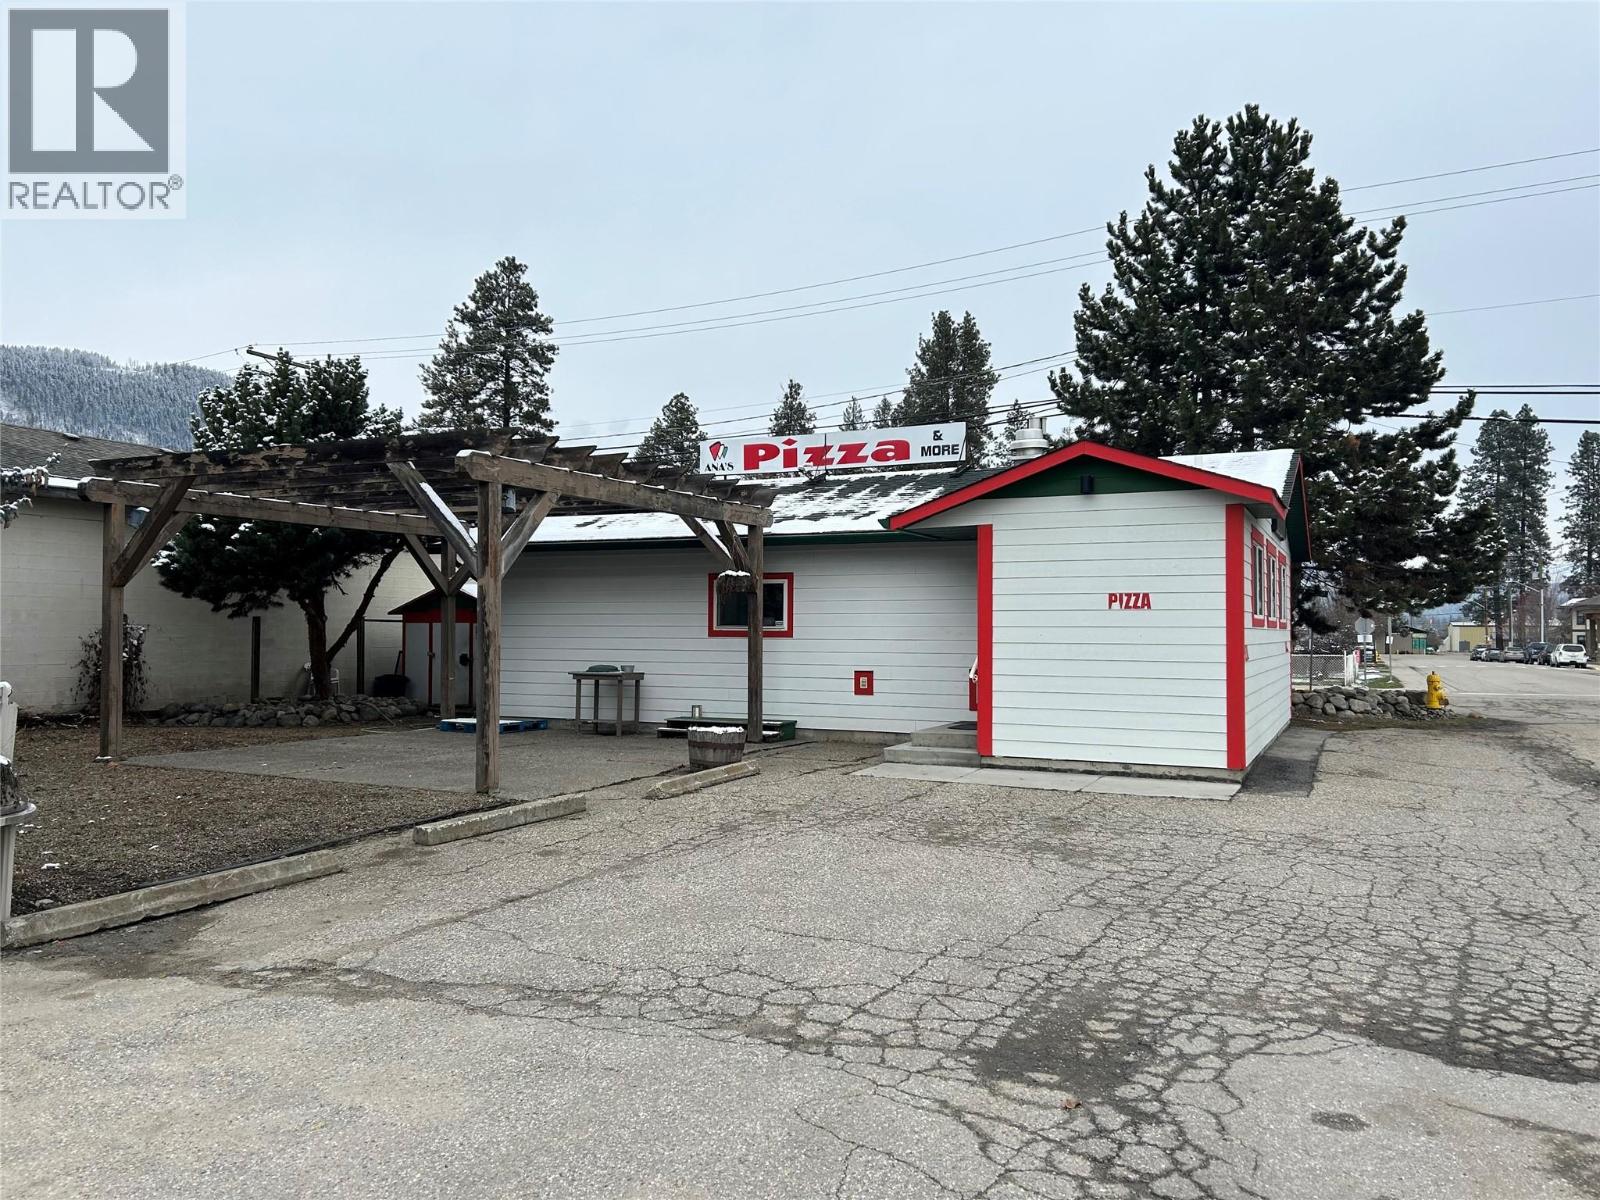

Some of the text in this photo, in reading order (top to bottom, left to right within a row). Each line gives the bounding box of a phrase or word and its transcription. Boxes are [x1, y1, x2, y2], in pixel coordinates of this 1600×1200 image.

[932, 430, 943, 441] &
[743, 437, 911, 471] Pizza
[920, 443, 960, 457] MORE
[704, 461, 734, 472] ANA'S
[1108, 592, 1152, 610] PIZZA
